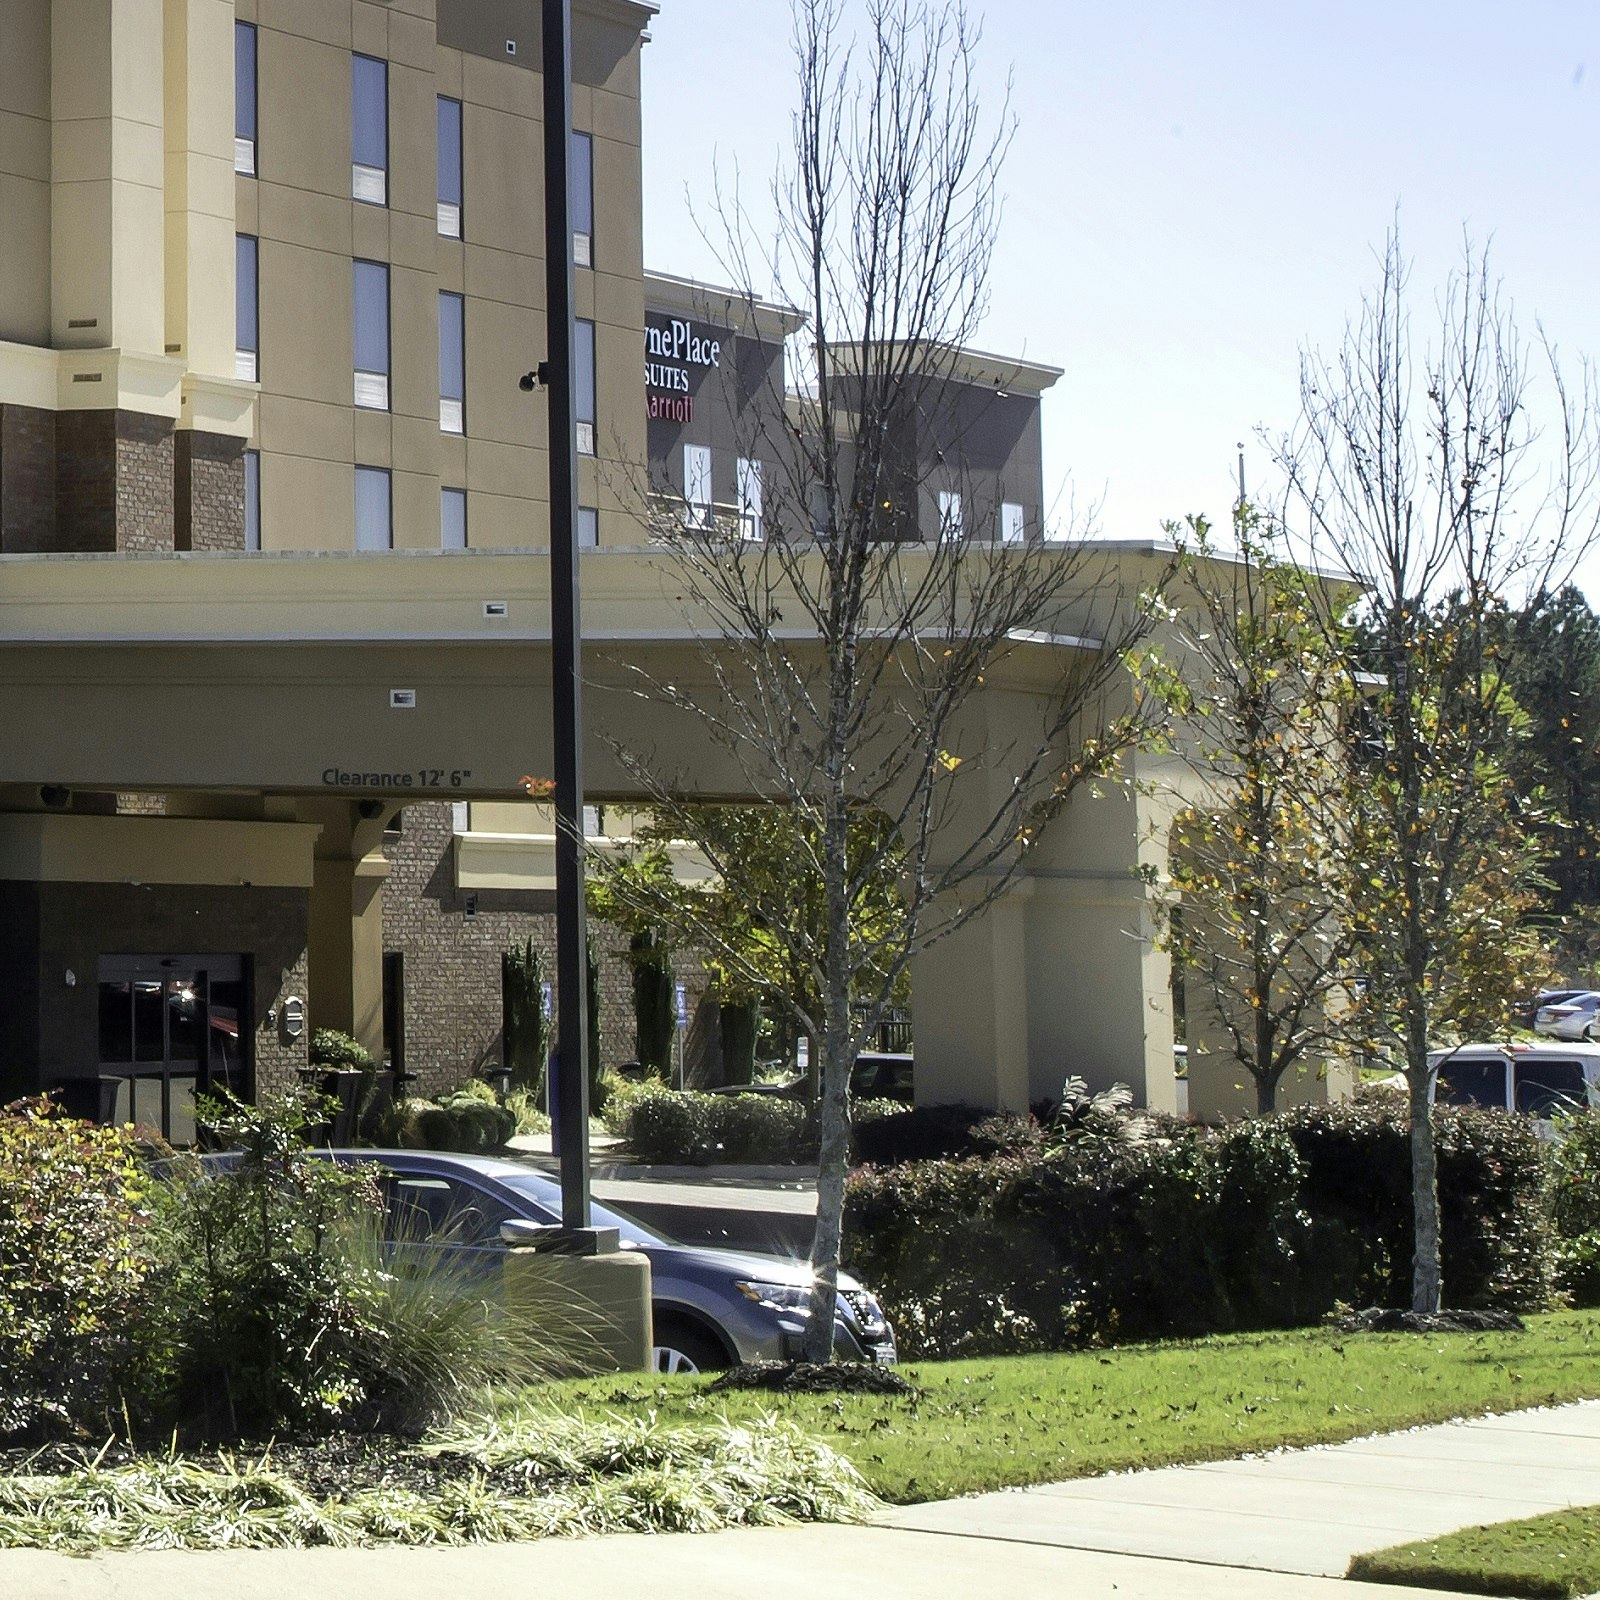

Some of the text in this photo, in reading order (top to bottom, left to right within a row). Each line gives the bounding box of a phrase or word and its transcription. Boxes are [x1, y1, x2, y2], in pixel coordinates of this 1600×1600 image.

[643, 319, 720, 368] nePlace
[644, 362, 689, 392] SUITES
[321, 768, 472, 788] Clearance 12' 6"
